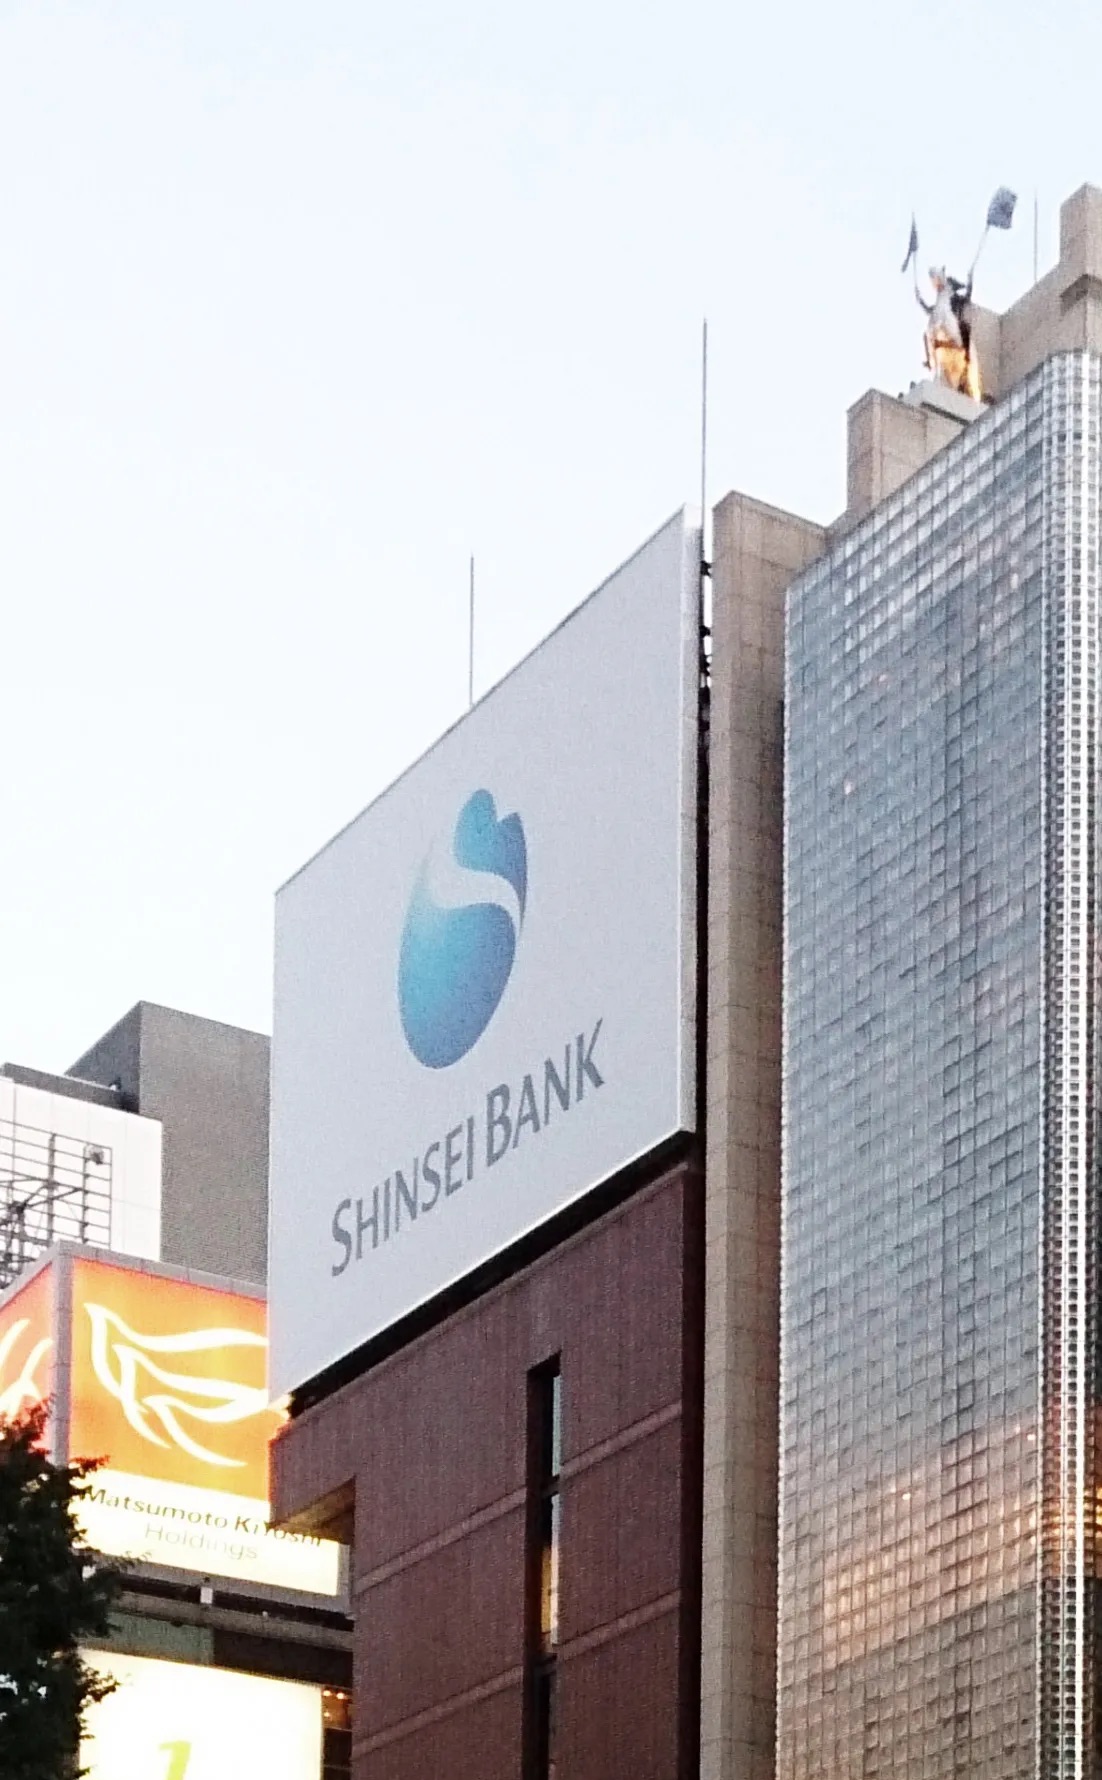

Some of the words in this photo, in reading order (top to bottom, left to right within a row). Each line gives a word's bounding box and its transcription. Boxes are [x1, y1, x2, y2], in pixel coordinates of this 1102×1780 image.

[331, 1115, 475, 1277] SHINSEI
[486, 1017, 605, 1168] BANK
[84, 1484, 229, 1529] Matsumoto
[144, 1522, 259, 1561] Holdings
